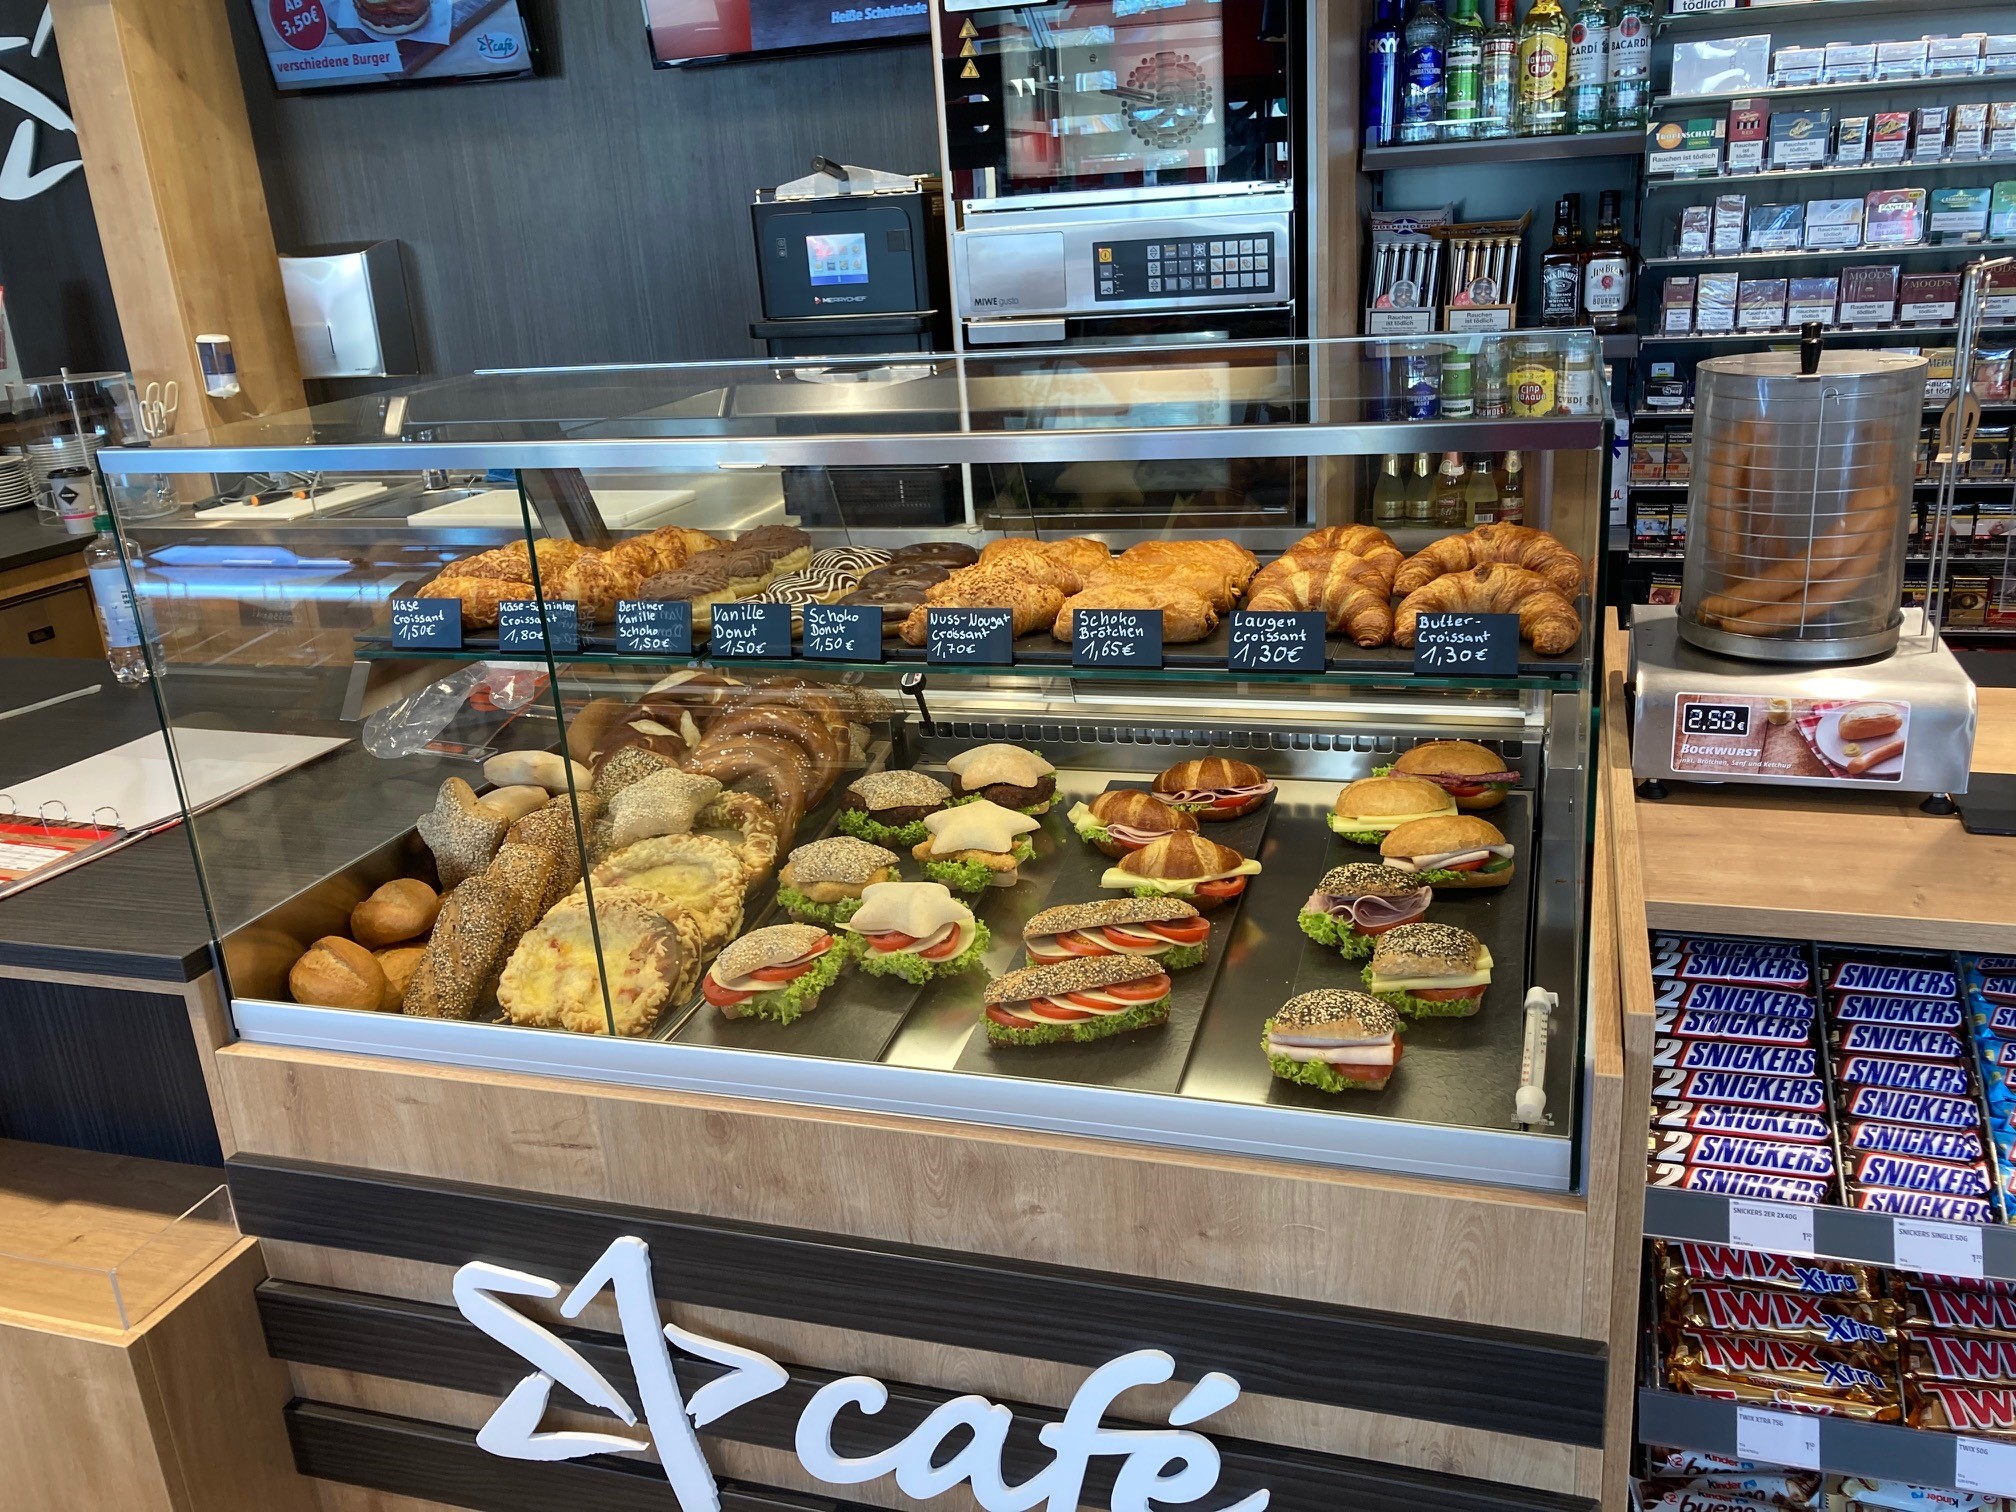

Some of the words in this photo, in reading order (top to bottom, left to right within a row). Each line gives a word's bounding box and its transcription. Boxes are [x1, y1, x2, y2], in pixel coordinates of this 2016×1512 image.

[281, 5, 320, 37] 3,50€
[831, 9, 863, 24] Heiße
[864, 2, 928, 20] Schokolade
[1369, 38, 1400, 53] SKYY
[1611, 36, 1649, 51] BACARDÍ
[276, 54, 350, 73] verschiedene
[352, 52, 391, 67] Burger
[1530, 63, 1551, 74] Club
[1652, 155, 1681, 163] Rauchen
[1692, 152, 1716, 160] tödlich
[1880, 203, 1912, 211] PANTER
[1849, 271, 1892, 281] MOODS
[1986, 264, 2016, 273] OODS
[1910, 279, 1952, 288] MOODS
[974, 297, 998, 306] MIWE
[998, 297, 1019, 307] gusto
[1592, 297, 1621, 305] BOURBON
[392, 600, 419, 611] Käse
[618, 601, 664, 612] Berliner
[393, 610, 444, 625] Croissant
[618, 611, 656, 624] Vanille
[713, 605, 766, 623] Vanille
[808, 608, 859, 625] Schoko
[930, 612, 1011, 630] Nuss-Nougat
[1079, 611, 1137, 627] Schoko
[1234, 612, 1296, 632] Laugen
[1418, 614, 1481, 629] Butter-
[398, 624, 436, 640] 1,50€
[503, 629, 544, 644] 1,80€
[619, 625, 658, 637] Schoko
[714, 625, 757, 640] Donut
[809, 624, 846, 637] Donut
[1078, 626, 1144, 640] Brötchen
[1418, 631, 1491, 643] Croissant
[628, 638, 670, 651] 1,50€
[719, 640, 767, 656] 1,50€
[931, 644, 976, 659] 1,70€
[1081, 641, 1136, 661] 1,65€
[1233, 643, 1304, 667] 1,30€
[1421, 645, 1489, 666] 1,30€
[1680, 743, 1761, 757] BOCKWURST
[1697, 757, 1730, 767] Brötchen,
[1731, 759, 1748, 767] Senf
[1763, 761, 1792, 770] Ketchup
[1652, 952, 1682, 976] 2
[1686, 954, 1809, 980] SNICKERS
[1839, 964, 1955, 996] SNICKERS
[1654, 980, 1687, 1008] 2
[1691, 984, 1816, 1020] SNICKERS
[1842, 996, 1960, 1025] SNICKERS
[1654, 1009, 1679, 1033] 2
[1683, 1011, 1810, 1040] SNICKERS
[1652, 1039, 1683, 1067] 2
[1687, 1042, 1817, 1074] SNICKERS
[1850, 1059, 1967, 1094] SNICKERS
[1653, 1069, 1687, 1097] 2
[1691, 1072, 1824, 1105] SNICKERS
[1856, 1089, 1979, 1128] SNICKERS
[1658, 1100, 1694, 1127] 2
[1698, 1104, 1830, 1137] SNICKERS
[1656, 1131, 1693, 1162] 2
[1697, 1136, 1832, 1174] SNICKERS
[1863, 1157, 1991, 1197] SNICKERS
[1733, 1207, 1763, 1217] SNICKERS
[1763, 1210, 1776, 1218] 2ER
[1776, 1211, 1798, 1221] 2X40G
[1898, 1228, 1931, 1238] SNICKERS
[1931, 1232, 1954, 1241] SINGLE
[1794, 1267, 1858, 1292] Xtra
[1689, 1281, 1826, 1329] TWIX
[1819, 1313, 1888, 1343] Xtra
[1906, 1281, 2016, 1329] TWI
[1682, 1330, 1824, 1371] TWIX
[1816, 1361, 1887, 1390] Xtra
[1910, 1332, 2016, 1379] TWI
[1738, 1413, 1755, 1423] TWIX
[1755, 1416, 1771, 1425] XTRA
[796, 1349, 1270, 1512] café
[1958, 1443, 1975, 1454] TWIX
